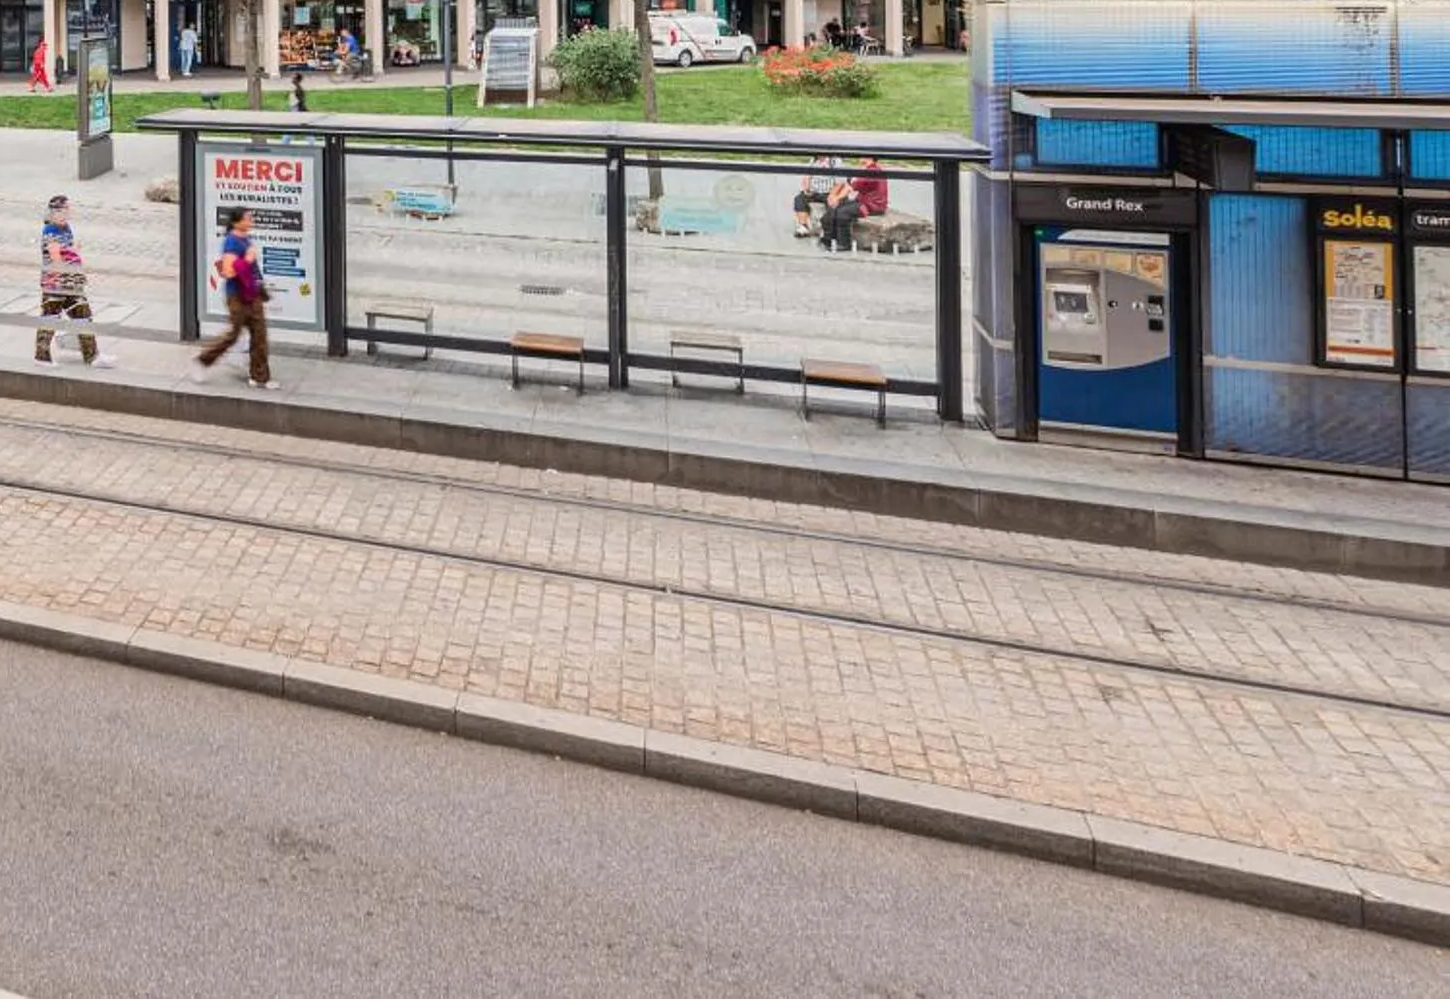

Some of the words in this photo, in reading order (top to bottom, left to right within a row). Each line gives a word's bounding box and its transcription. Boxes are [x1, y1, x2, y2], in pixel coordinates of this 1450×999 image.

[215, 158, 303, 183] MERCI
[1066, 196, 1113, 210] Grand
[1115, 198, 1144, 212] Rex
[1323, 203, 1393, 230] Soléa
